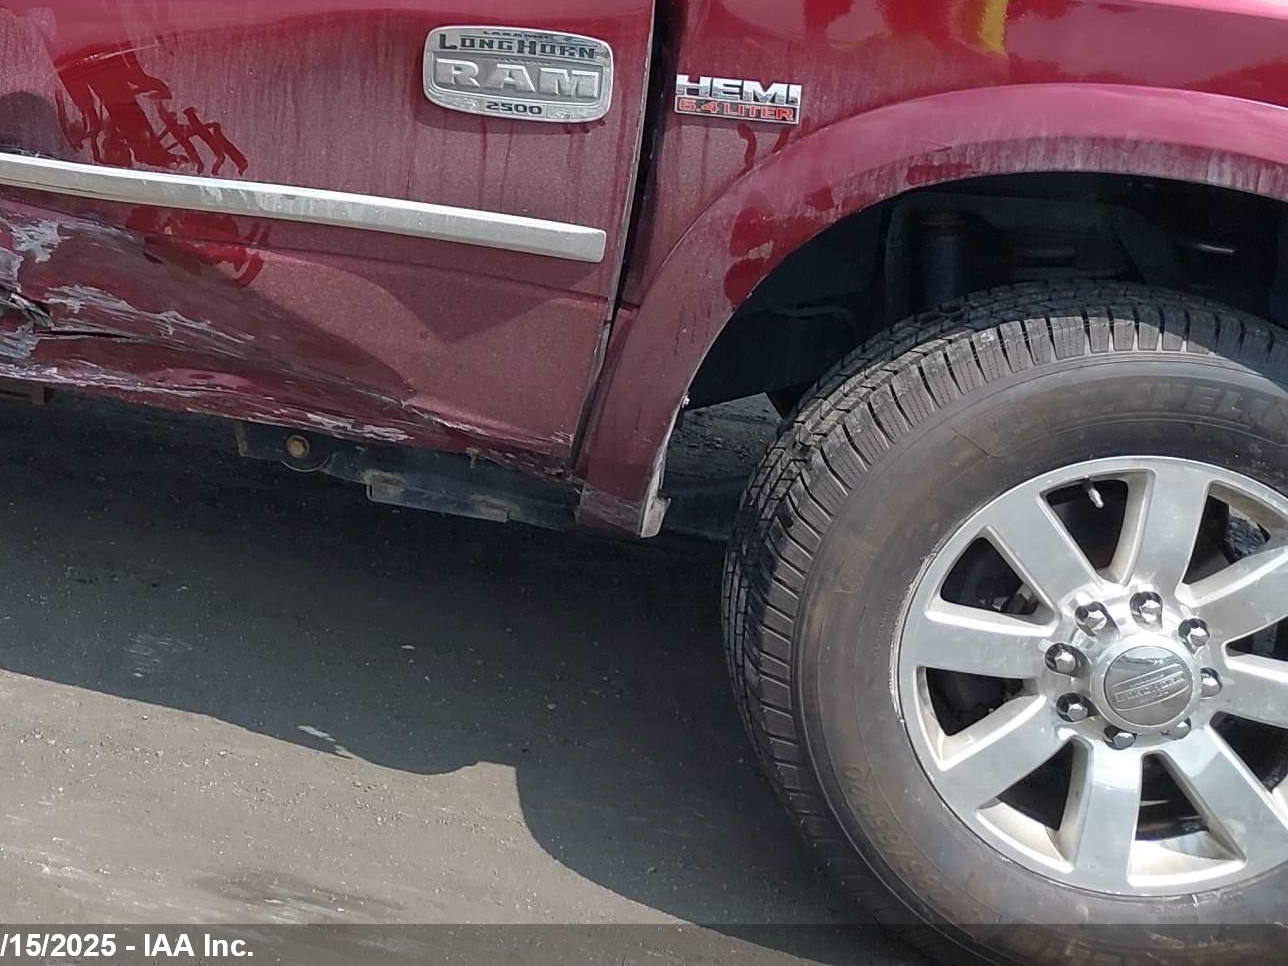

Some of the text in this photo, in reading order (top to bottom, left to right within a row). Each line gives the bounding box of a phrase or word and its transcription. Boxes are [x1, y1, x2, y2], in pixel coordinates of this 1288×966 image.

[435, 57, 602, 100] RAM
[675, 74, 802, 107] HEMI
[486, 101, 542, 115] 2500
[679, 98, 794, 121] 6.4 LITER
